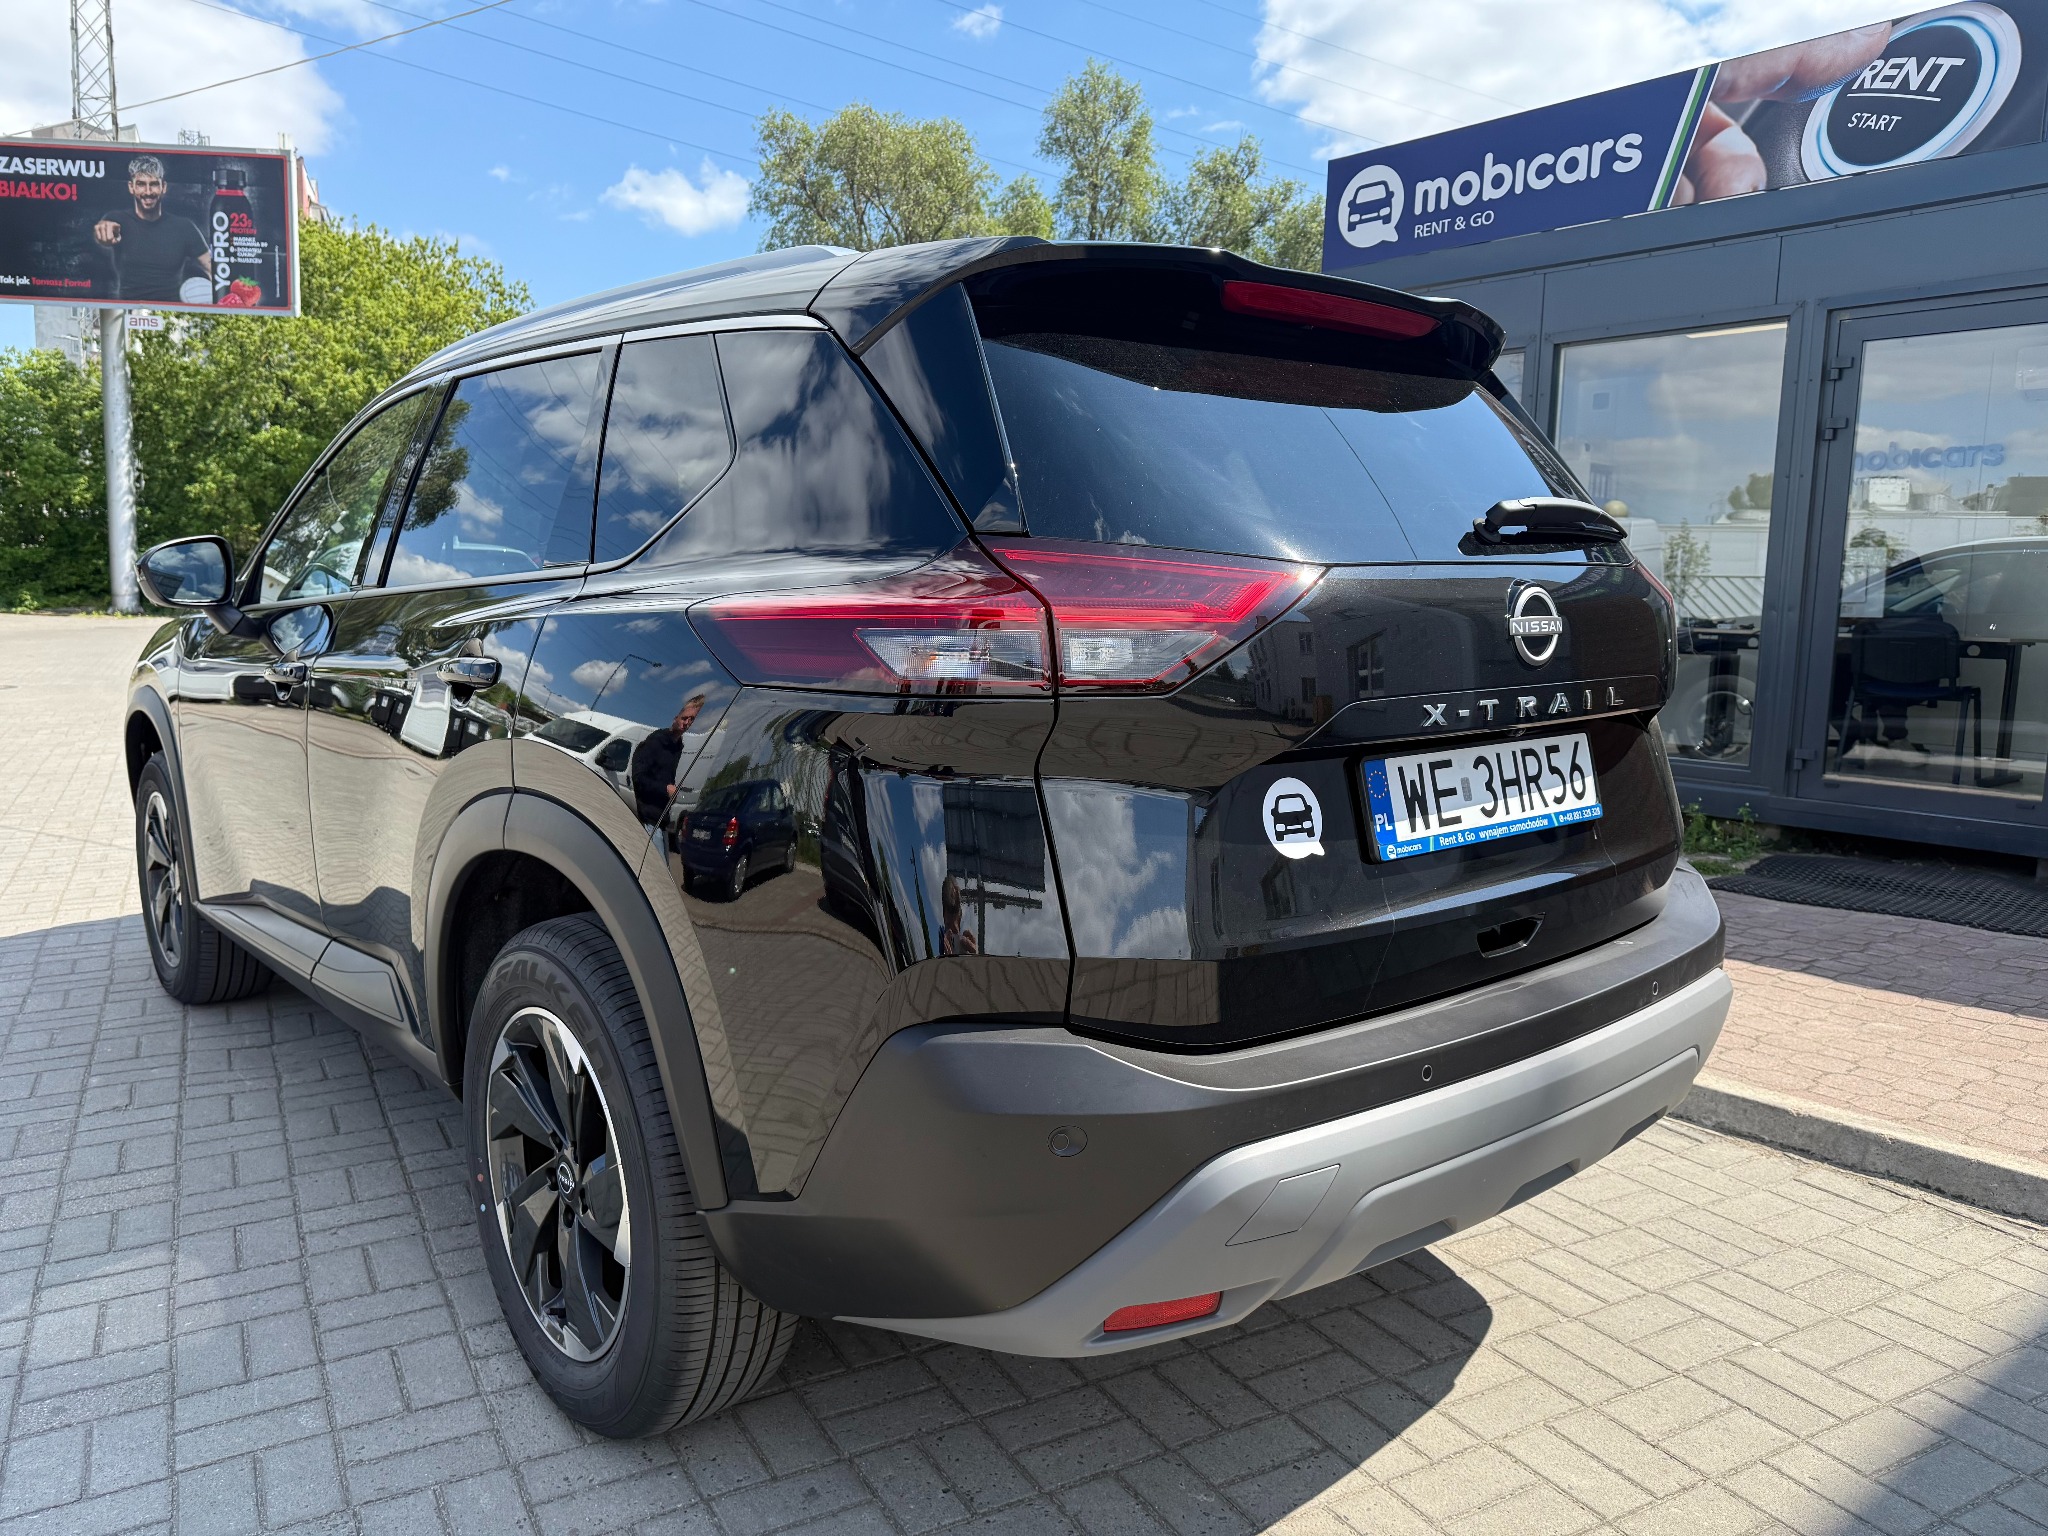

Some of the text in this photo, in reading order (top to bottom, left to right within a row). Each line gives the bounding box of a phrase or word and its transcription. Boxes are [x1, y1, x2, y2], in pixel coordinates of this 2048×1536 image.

[1851, 57, 1966, 92] RENT
[1847, 112, 1902, 131] START
[0, 156, 105, 178] ZASERWUJ
[1414, 133, 1643, 215] mobicars
[0, 180, 77, 201] BIAŁKO!
[1414, 210, 1495, 238] RENT & GO
[213, 211, 230, 291] YoPRO
[0, 275, 15, 285] Tak
[16, 275, 30, 286] jak
[129, 316, 159, 327] ams
[1512, 619, 1563, 633] NISSAN
[1422, 687, 1624, 727] X-TRAIL
[1397, 740, 1587, 834] WE 3HR56
[1374, 812, 1393, 833] PL
[1439, 836, 1457, 846] Rent
[1457, 833, 1464, 842] &
[1465, 831, 1475, 841] Go
[1479, 825, 1508, 840] wynajem
[1509, 817, 1549, 833] samochodów
[491, 959, 612, 1081] FALKEN
